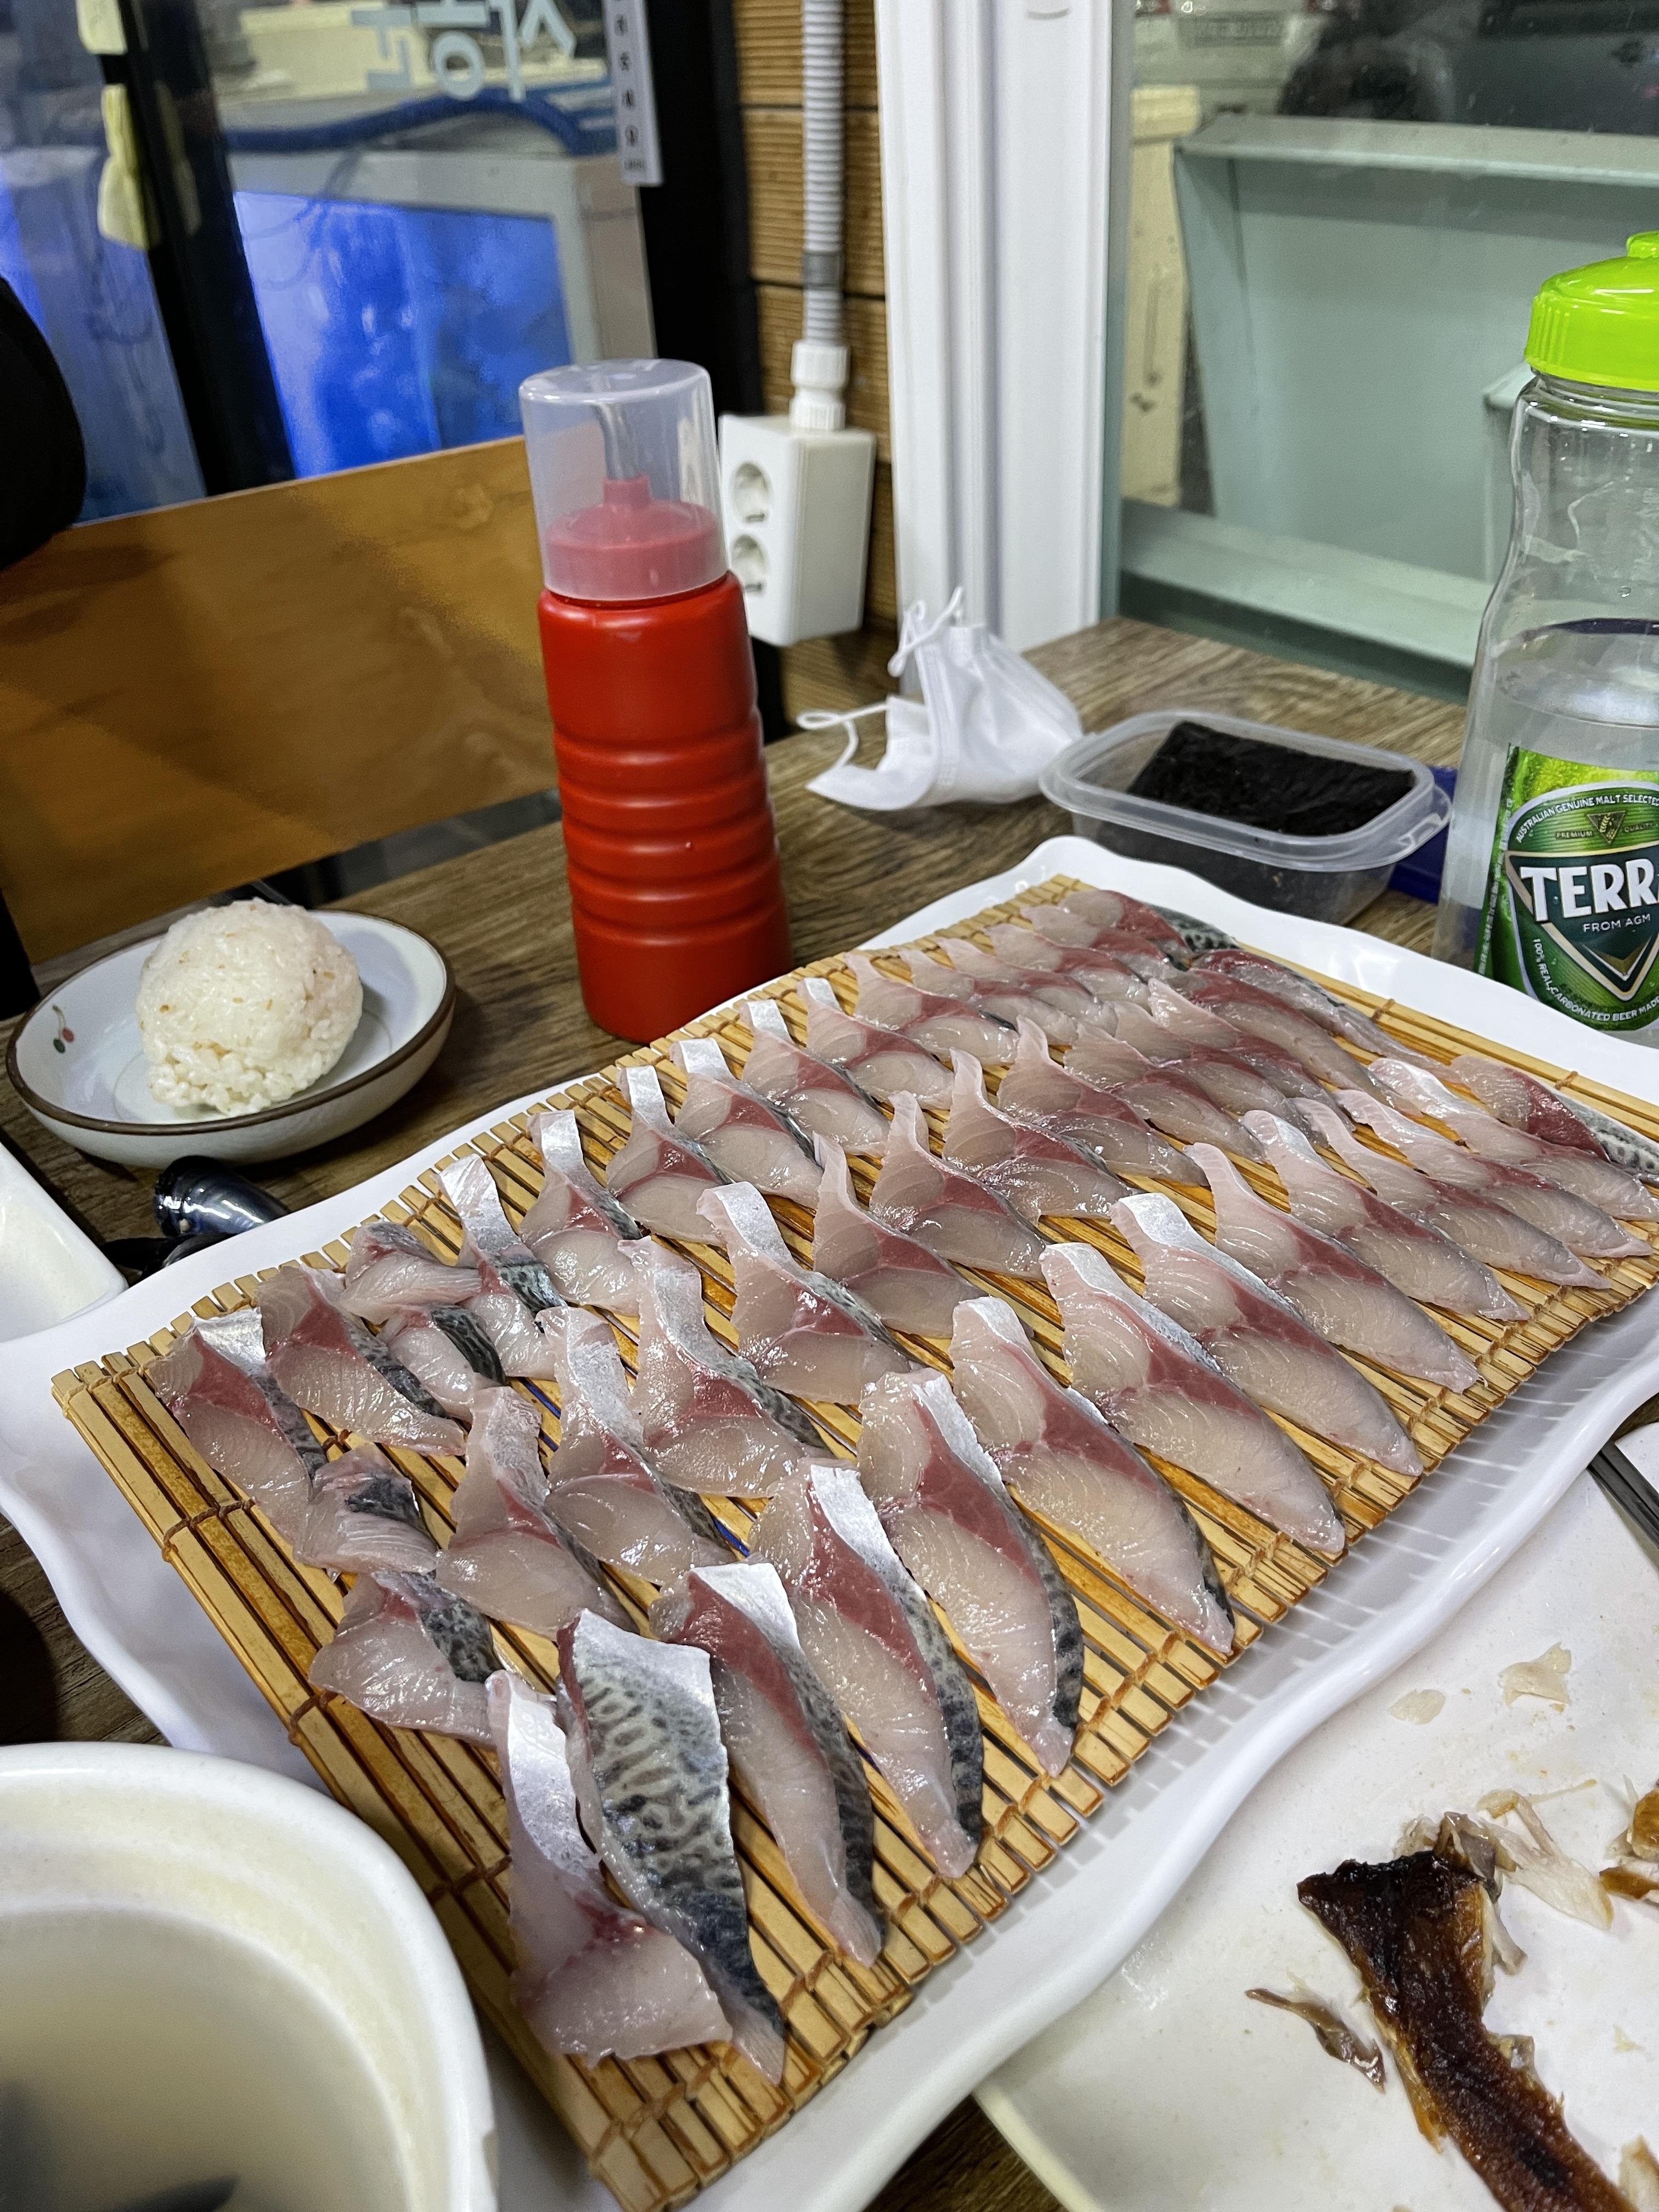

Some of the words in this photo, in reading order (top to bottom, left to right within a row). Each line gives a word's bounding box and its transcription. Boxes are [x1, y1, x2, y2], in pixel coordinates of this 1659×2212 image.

[1516, 807, 1556, 843] AUSTRALIAN
[1555, 798, 1594, 813] GENUINE
[1595, 794, 1621, 804] MALT
[1520, 859, 1659, 922] TERR
[1583, 920, 1621, 933] FROM
[1625, 913, 1651, 926] AGM
[1551, 988, 1610, 1021] CARBONATED
[1612, 1009, 1638, 1022] BEER
